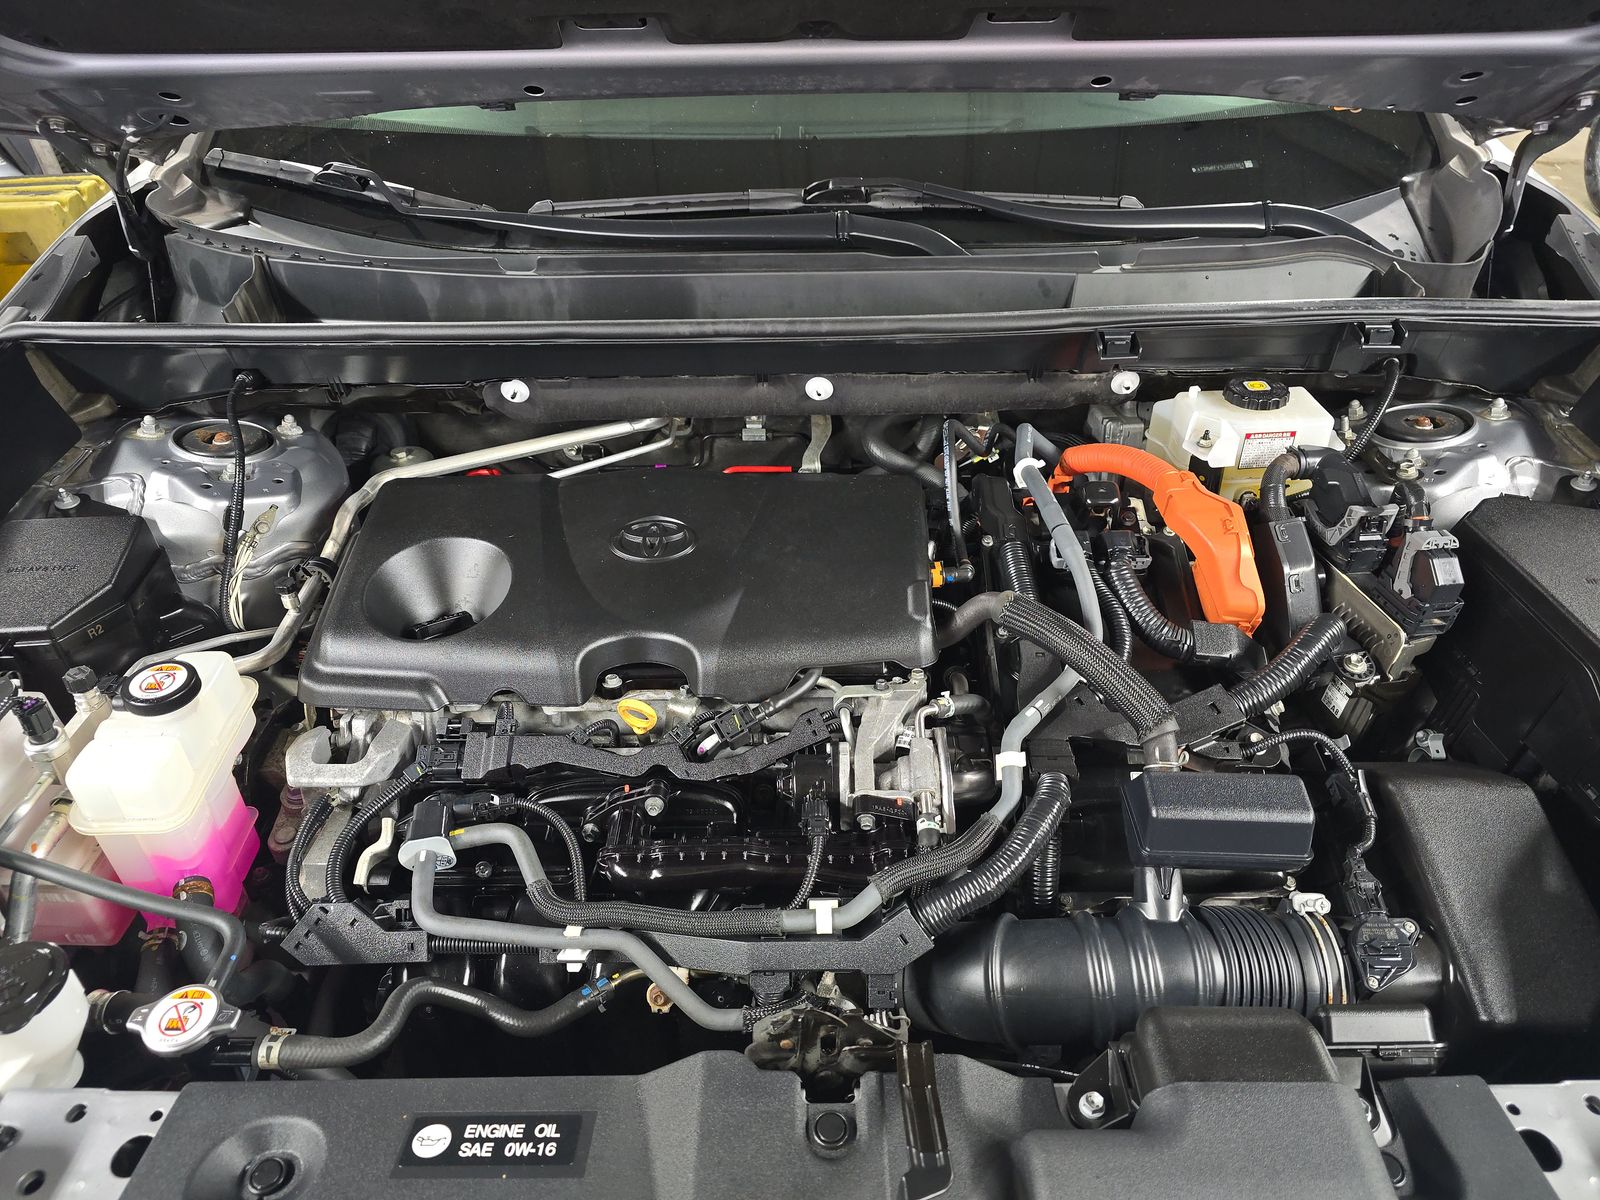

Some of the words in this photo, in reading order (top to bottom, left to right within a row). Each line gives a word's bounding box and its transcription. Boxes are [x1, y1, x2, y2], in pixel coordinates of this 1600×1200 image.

[87, 624, 105, 639] R2
[464, 1124, 525, 1138] ENGINE
[534, 1124, 560, 1138] OIL
[458, 1142, 494, 1157] SAE
[504, 1142, 557, 1157] 0W-16
